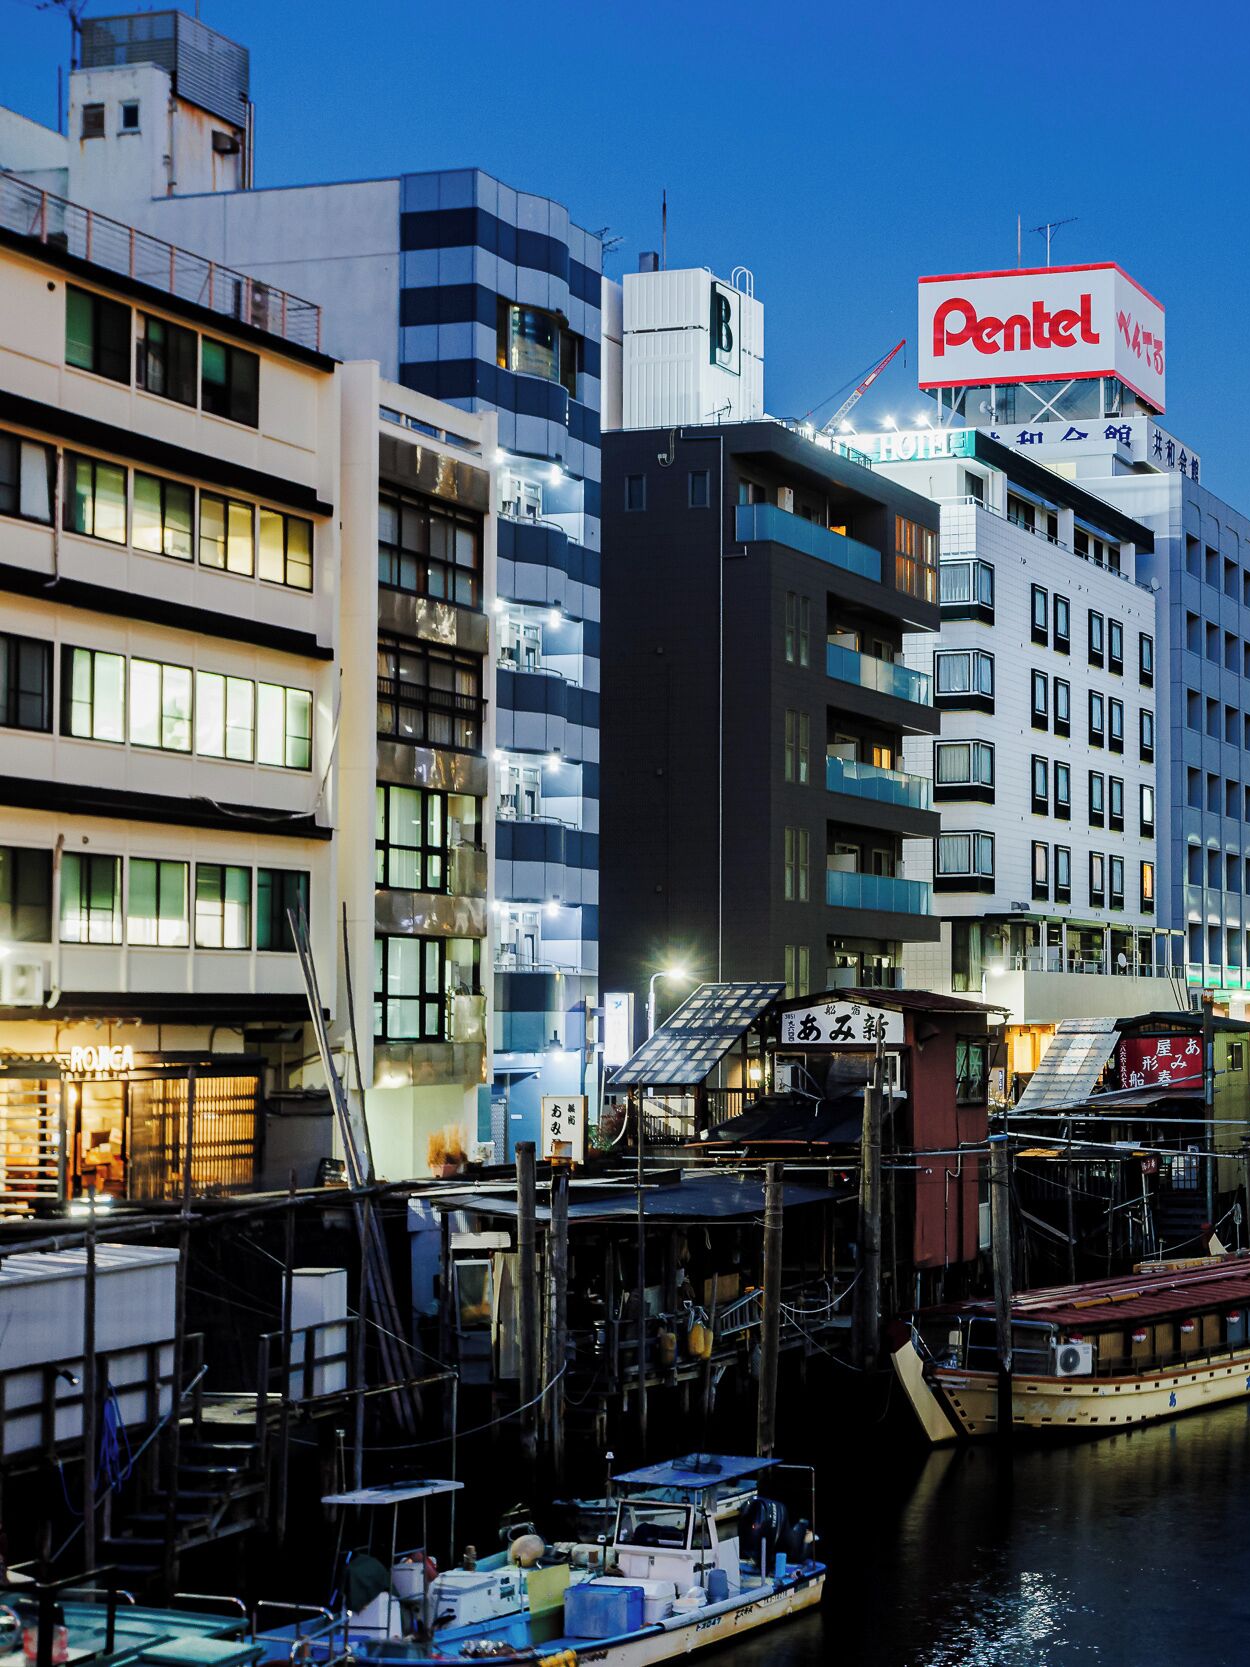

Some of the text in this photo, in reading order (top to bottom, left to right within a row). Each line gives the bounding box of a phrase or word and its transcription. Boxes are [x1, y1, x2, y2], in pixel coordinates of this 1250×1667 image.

[716, 291, 733, 353] B
[933, 293, 1100, 357] Pentel
[879, 433, 956, 462] HOTEL
[797, 1013, 889, 1042] あみ新
[550, 1103, 562, 1152] あみ
